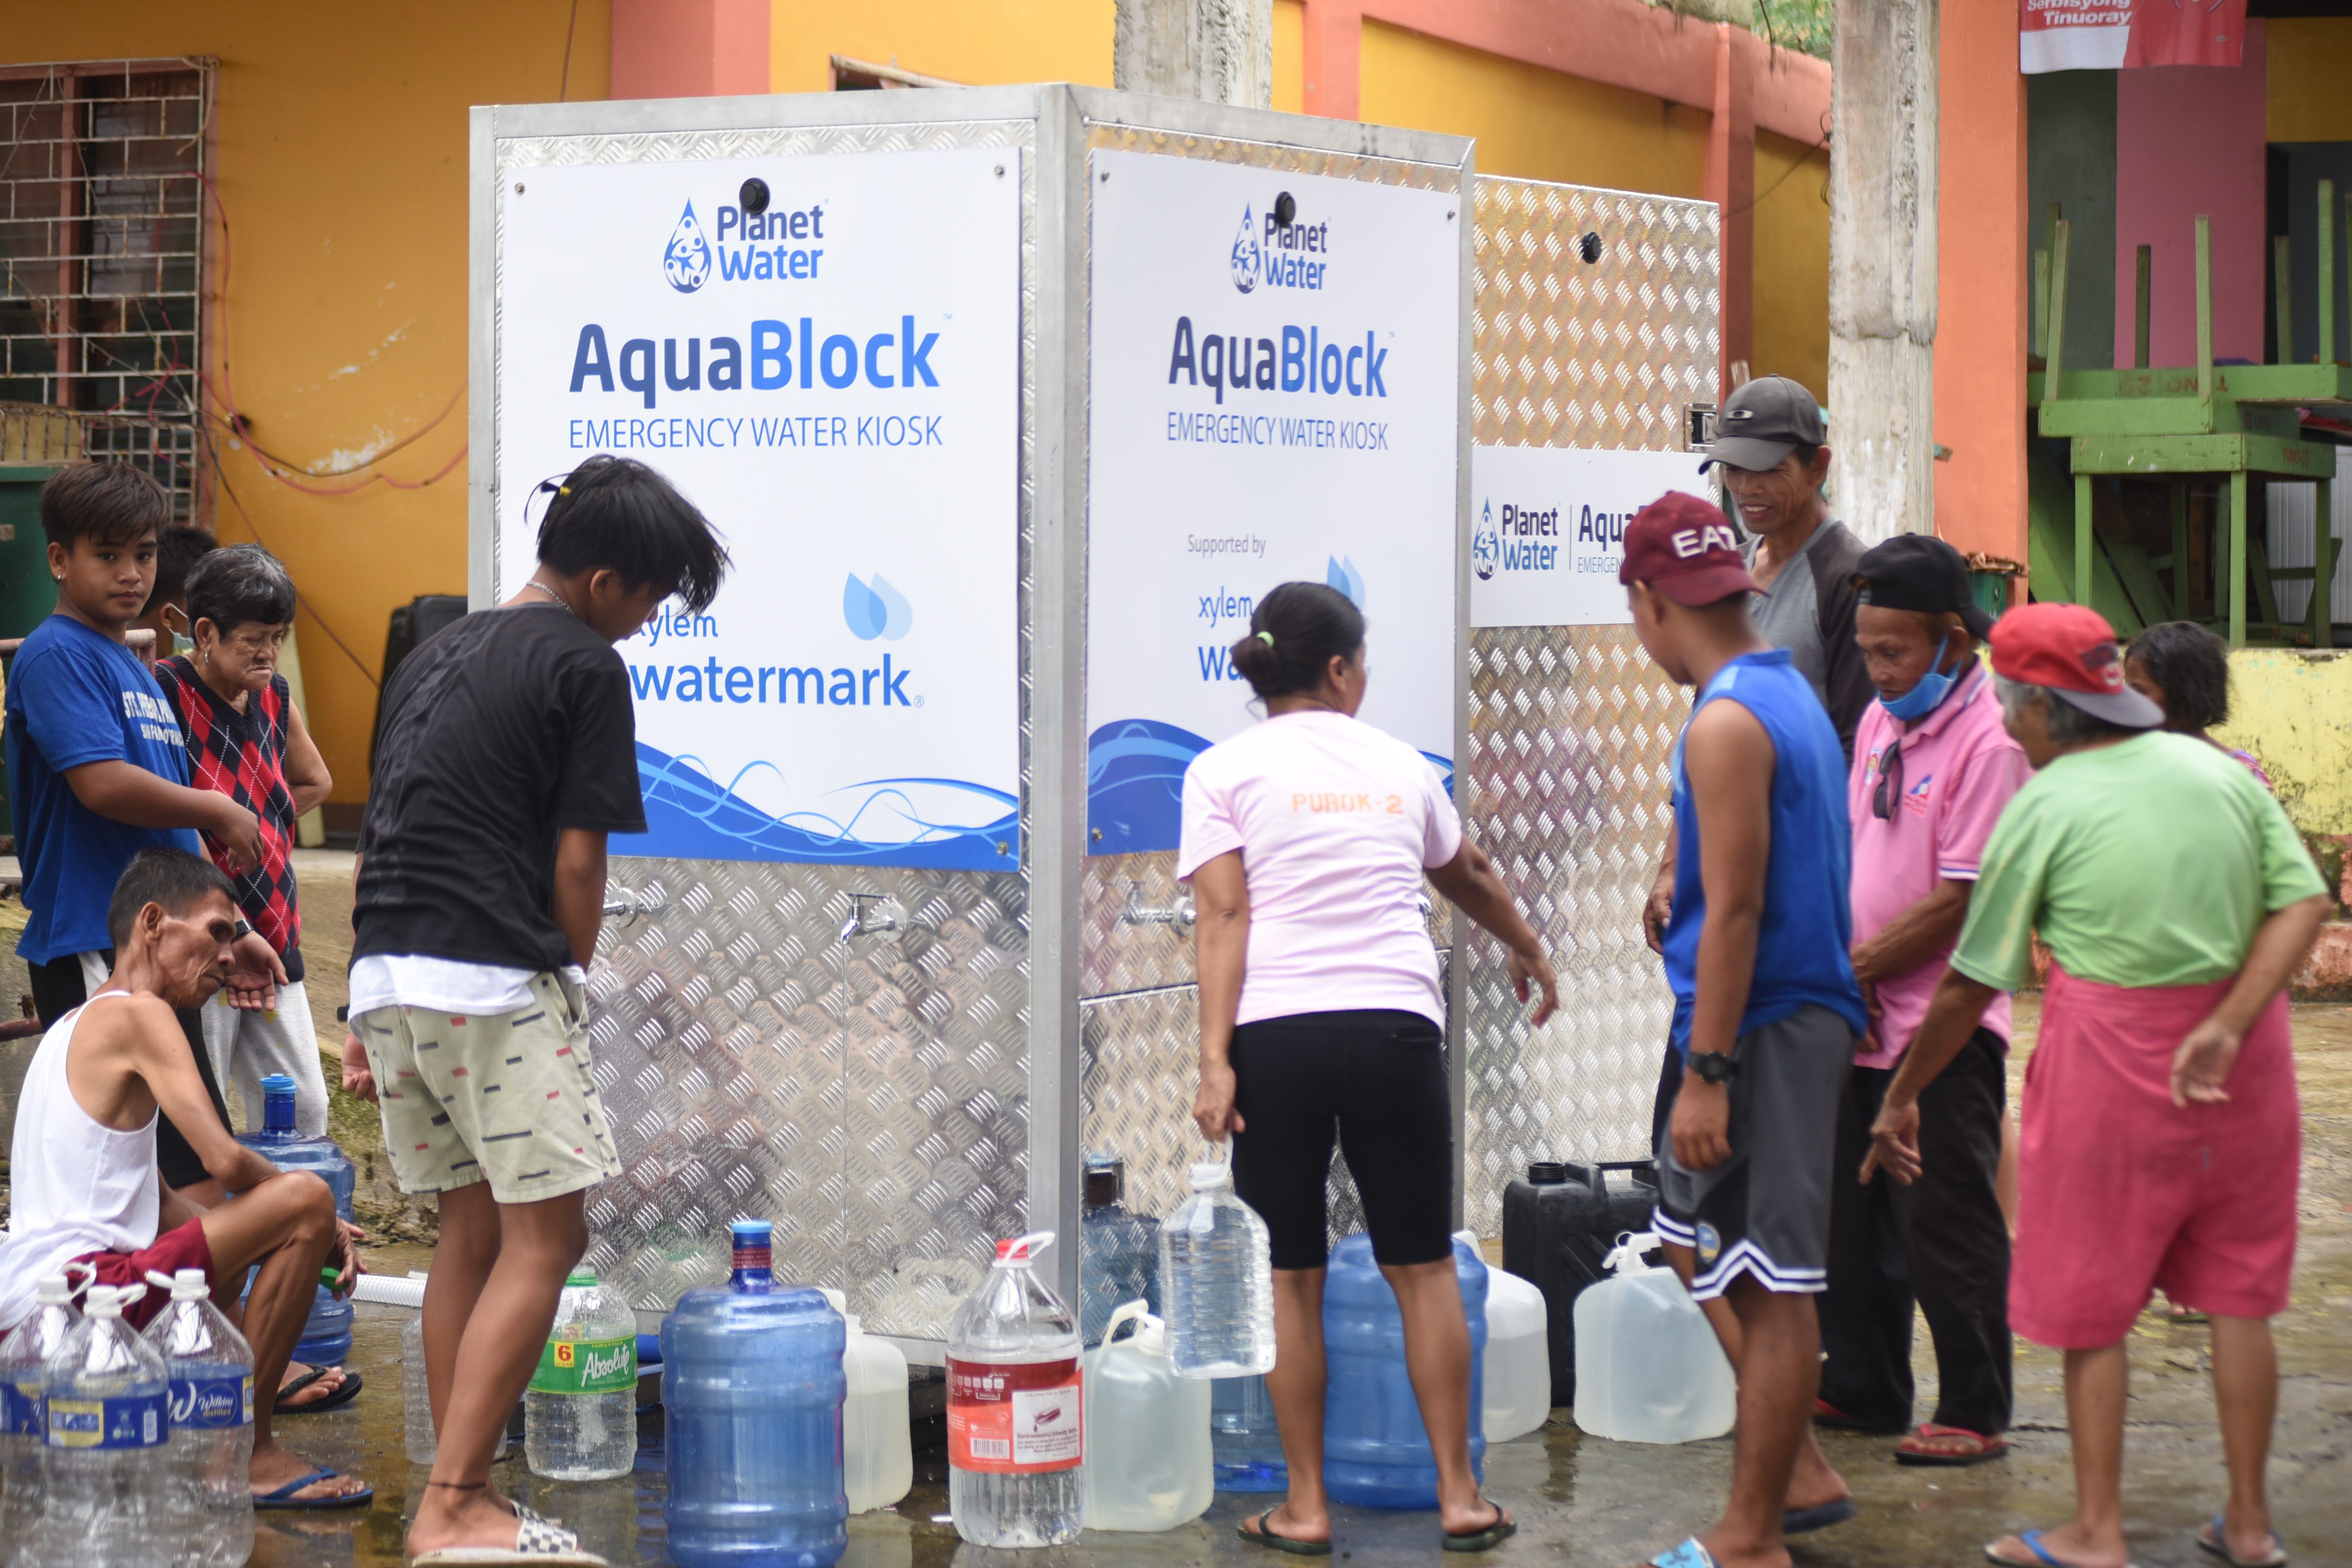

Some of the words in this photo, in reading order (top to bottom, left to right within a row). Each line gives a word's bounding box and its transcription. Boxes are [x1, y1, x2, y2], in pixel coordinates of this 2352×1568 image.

[2043, 10, 2133, 26] Tinuoray
[717, 205, 824, 242] Planet
[1265, 212, 1328, 254] Planet
[717, 244, 824, 281] Water
[1265, 250, 1327, 290] Water
[569, 314, 941, 410] AquaBlock
[1168, 315, 1388, 405] AquaBlock
[570, 418, 744, 449] EMERGENCY
[750, 416, 848, 448] WATER
[858, 415, 944, 447] KIOSK
[1167, 411, 1277, 446] EMERGENCY
[1280, 417, 1336, 448] WATER
[1340, 420, 1389, 450] KIOSK
[1502, 504, 1559, 536] Planet
[1187, 534, 1250, 558] Supported
[1253, 535, 1267, 559] by
[1502, 538, 1558, 571] Water
[1578, 557, 1623, 573] EMERGEN
[1198, 585, 1253, 628] xylem
[640, 604, 718, 647] ylem
[629, 653, 912, 707] watermark
[558, 1345, 571, 1362] 6
[581, 1343, 630, 1387] Absolute
[198, 1393, 234, 1411] Wilkins
